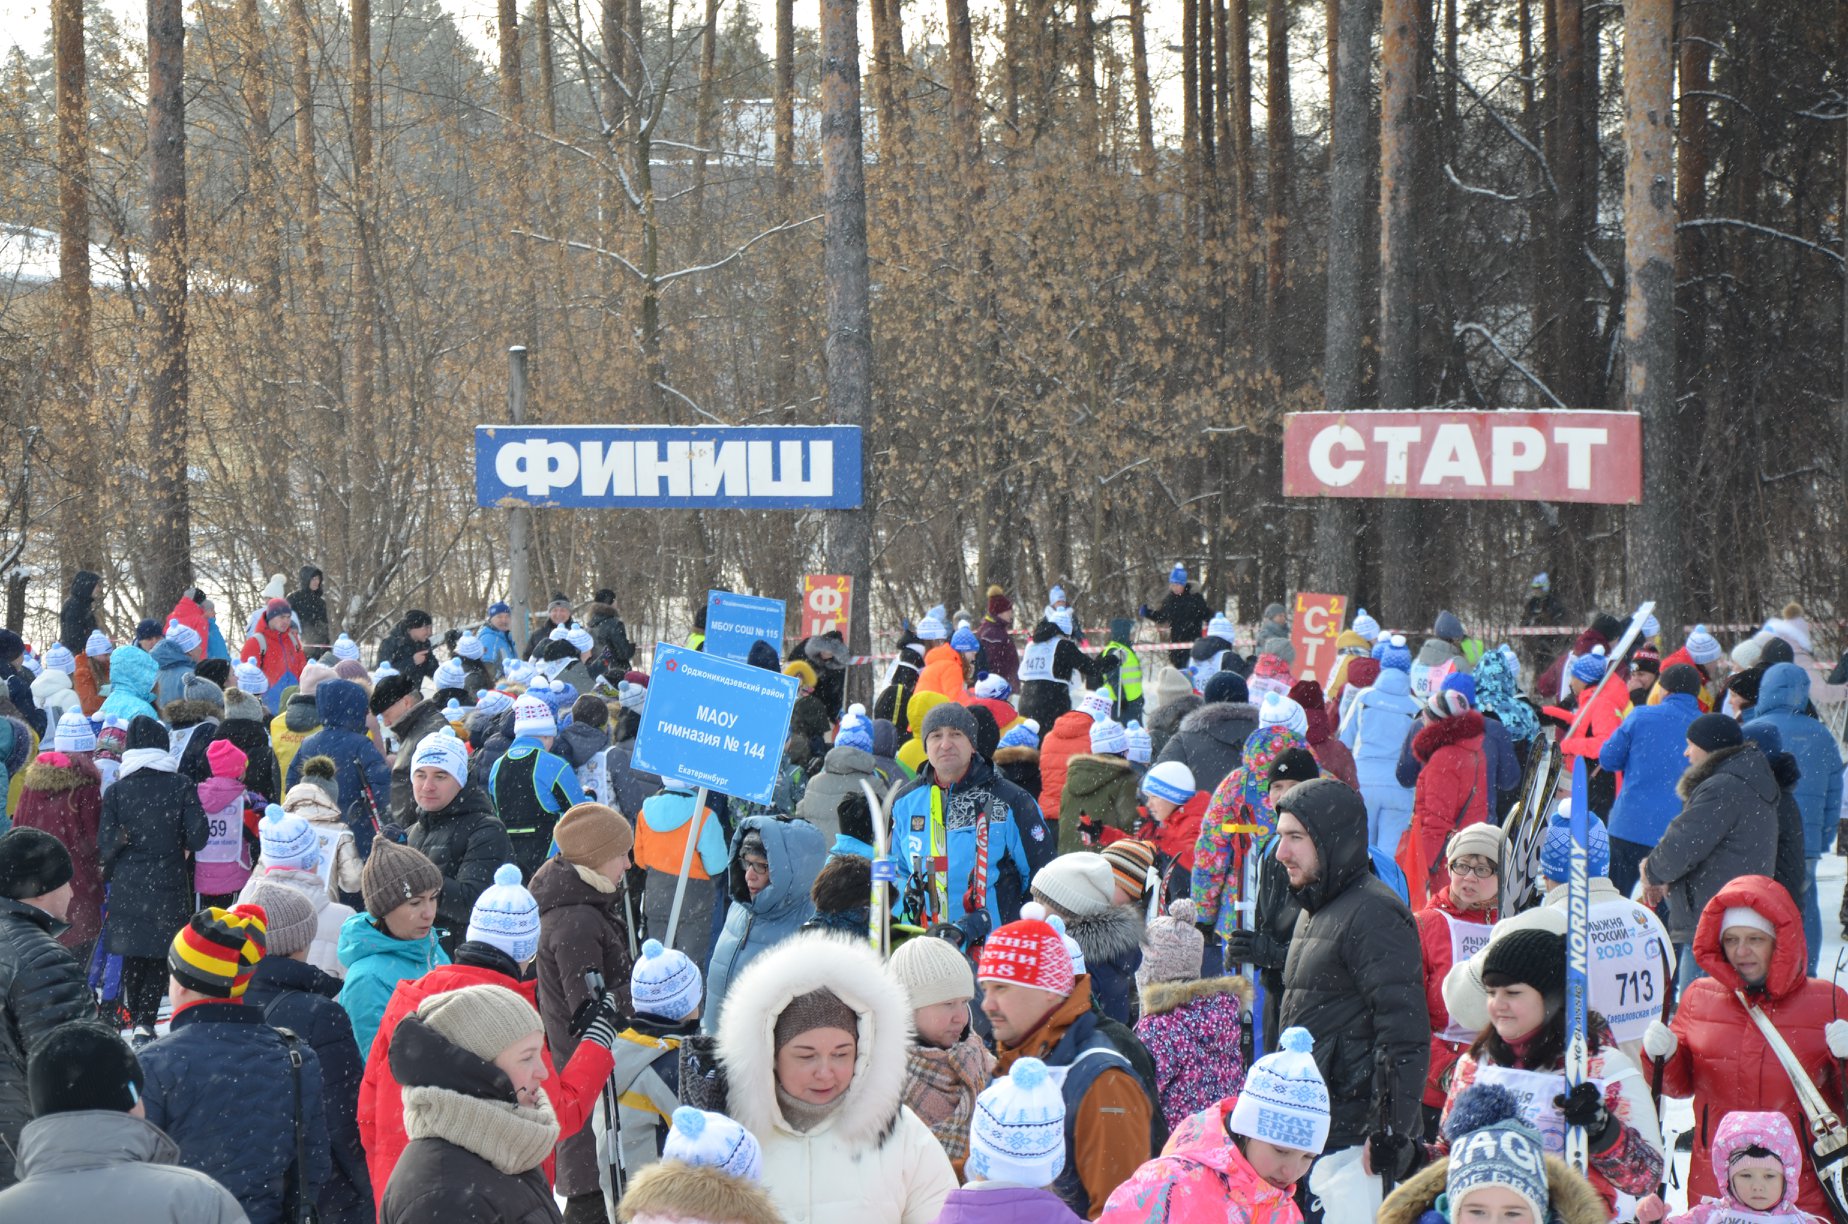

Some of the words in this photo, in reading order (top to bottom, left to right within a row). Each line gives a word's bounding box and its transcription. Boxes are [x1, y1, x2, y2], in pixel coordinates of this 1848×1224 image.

[1308, 423, 1608, 490] СТАРТ
[495, 438, 833, 497] ФИНИШ
[711, 621, 734, 632] МБОУ
[735, 624, 754, 635] СОШ
[755, 627, 764, 637] №
[766, 629, 779, 639] 115
[1025, 656, 1046, 670] 1473
[681, 664, 760, 693] Орджоникидзевский
[761, 687, 785, 699] район
[696, 705, 738, 729] МАОУ
[657, 720, 721, 748] гимназия
[723, 735, 740, 752] №
[743, 740, 766, 760] 144
[678, 764, 729, 785] Екатеринбург
[1570, 834, 1588, 976] NORDWAY
[1588, 916, 1625, 933] ЛЫЖНЯ
[1591, 928, 1630, 944] РОССИИ
[1596, 941, 1633, 960] 2020
[1615, 969, 1654, 1006] 713
[1607, 1008, 1650, 1025] Свердловская
[1258, 1117, 1315, 1138] ERIN
[1259, 1108, 1316, 1128] EKAT
[1257, 1126, 1312, 1147] BURG
